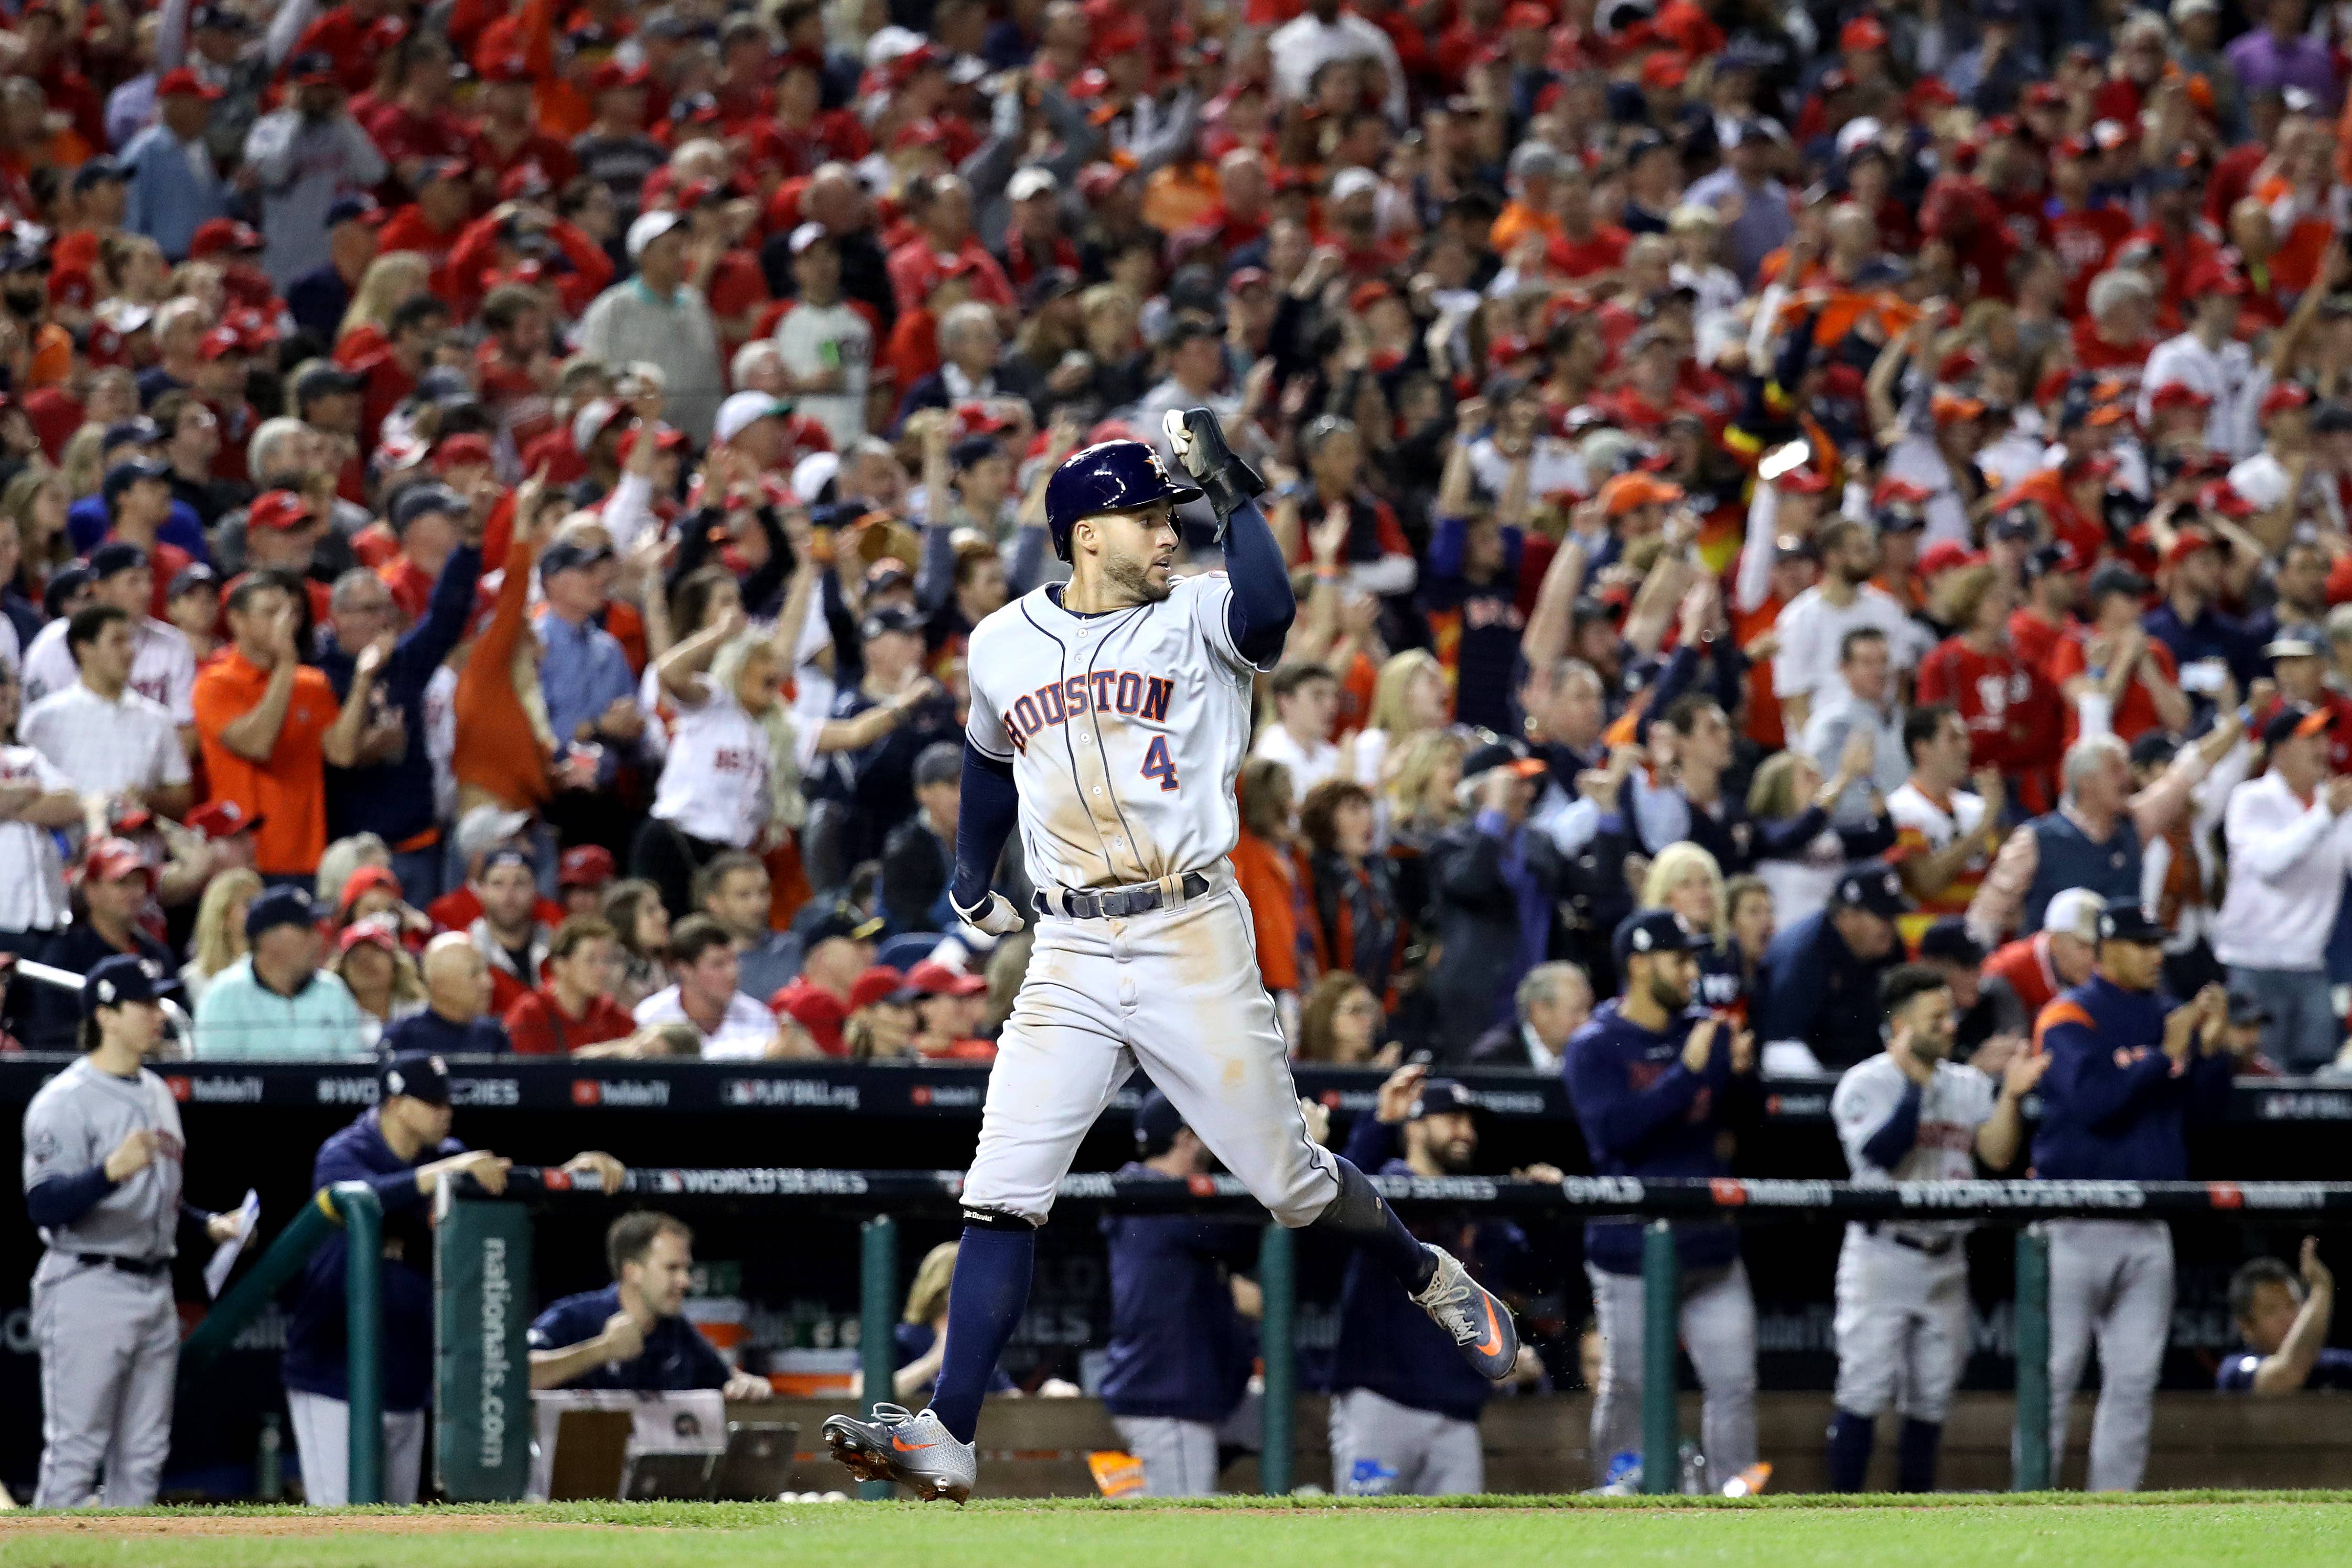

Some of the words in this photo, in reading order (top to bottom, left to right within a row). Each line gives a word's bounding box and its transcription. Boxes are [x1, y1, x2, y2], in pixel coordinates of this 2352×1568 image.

[1003, 669, 1175, 757] HOUSTON
[1140, 734, 1180, 792] 4
[480, 1237, 511, 1468] nationals.com
